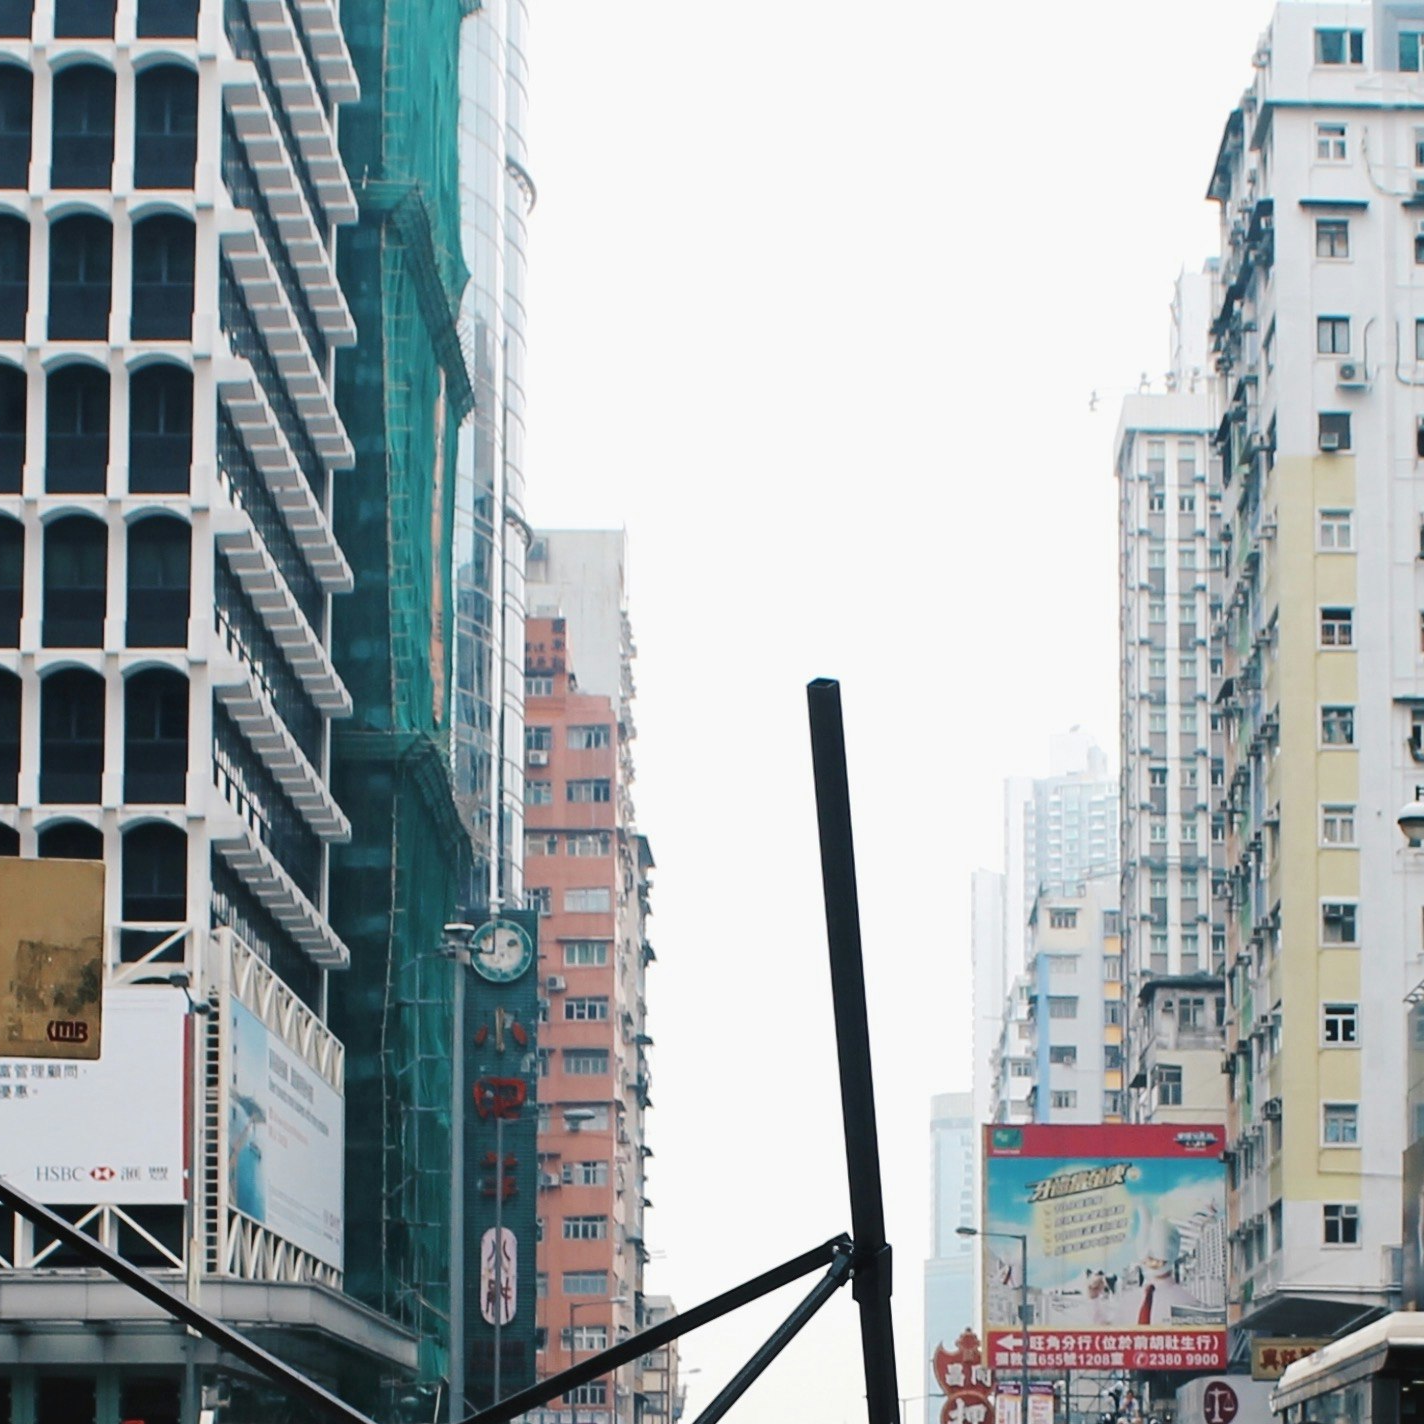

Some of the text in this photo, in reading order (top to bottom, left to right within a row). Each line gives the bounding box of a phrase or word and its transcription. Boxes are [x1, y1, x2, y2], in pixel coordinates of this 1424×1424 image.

[36, 1166, 84, 1182] HSBC
[1149, 1353, 1182, 1366] 2380
[1185, 1353, 1219, 1366] 9900
